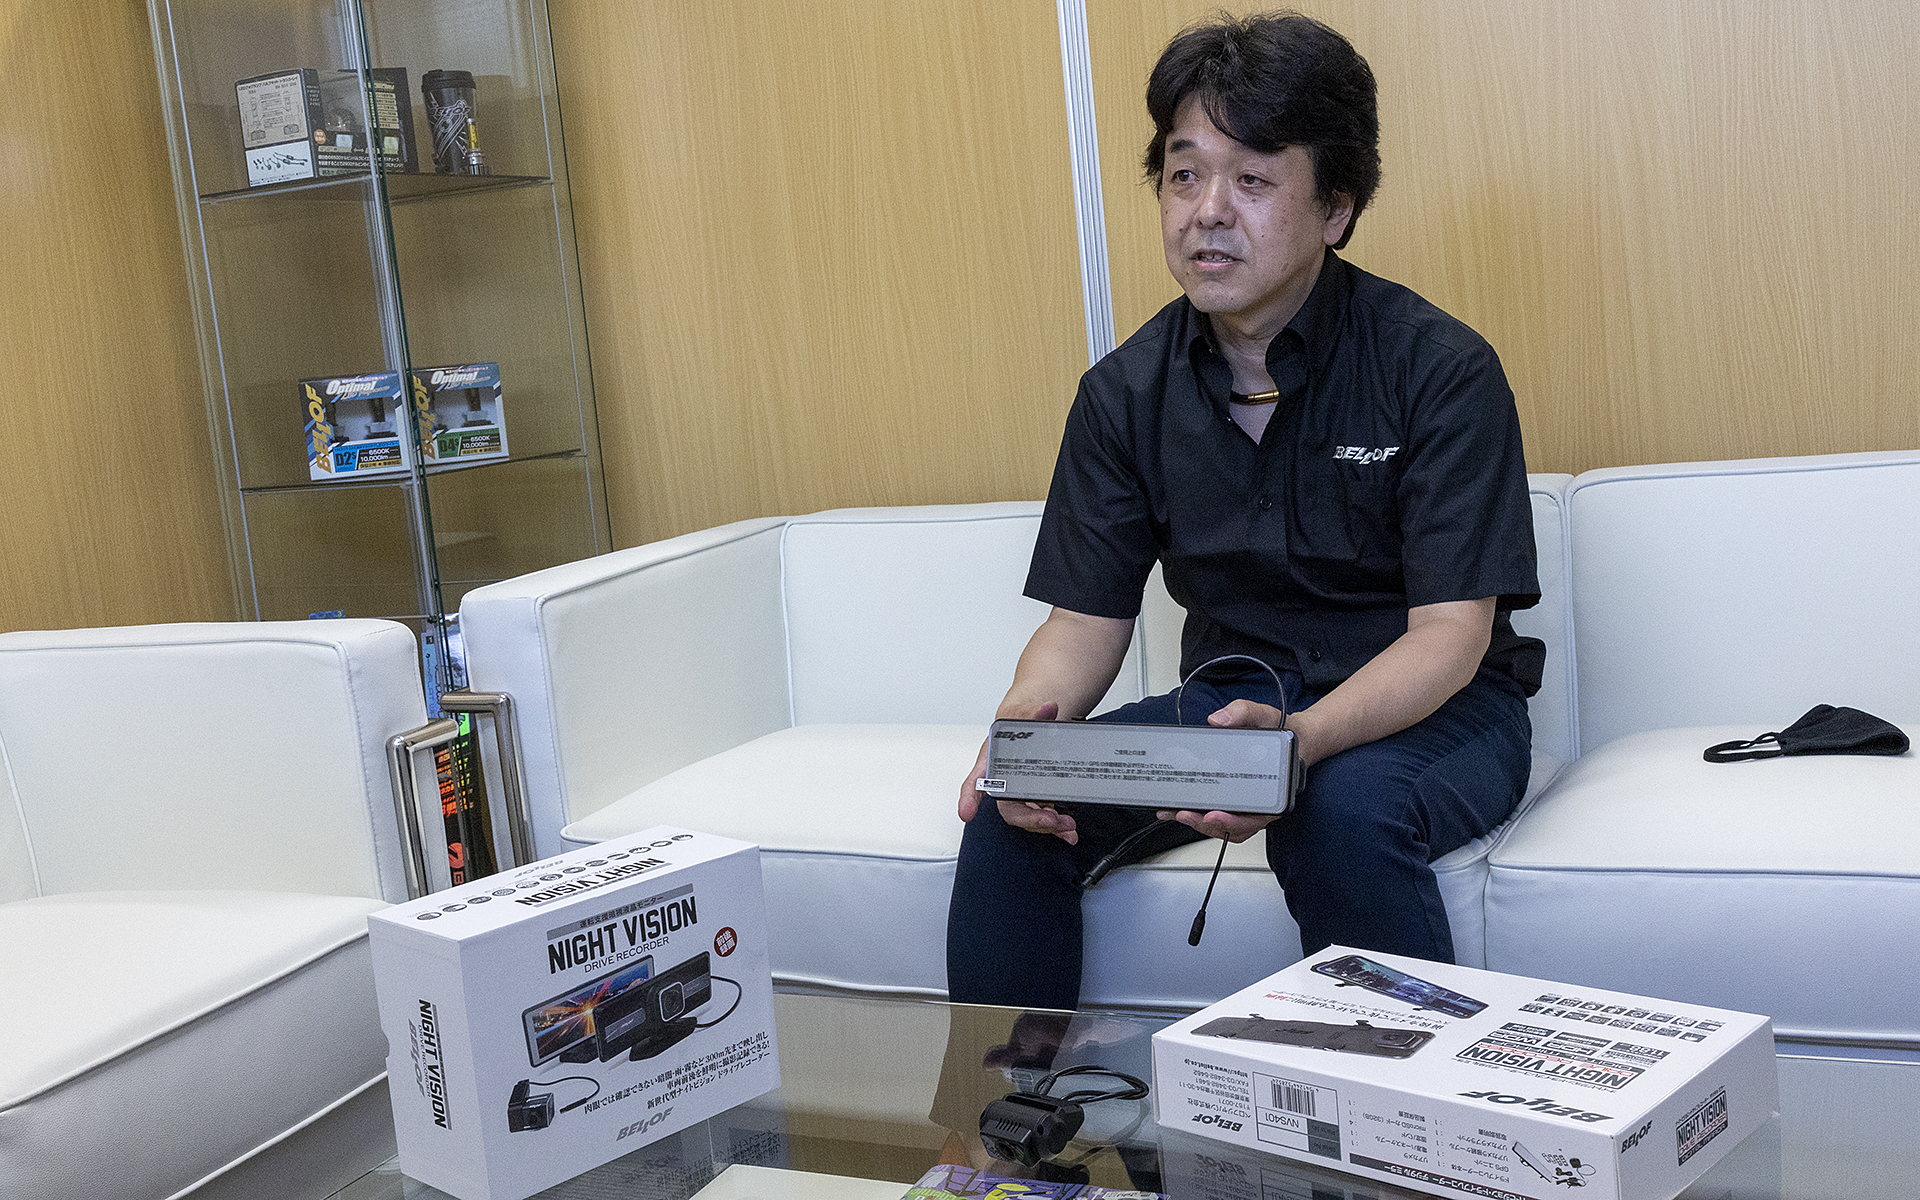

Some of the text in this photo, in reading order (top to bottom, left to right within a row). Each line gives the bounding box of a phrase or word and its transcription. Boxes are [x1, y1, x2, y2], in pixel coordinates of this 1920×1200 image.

[326, 380, 377, 395] Optimal
[431, 370, 478, 385] Optimal
[305, 383, 332, 473] BELLOF
[1333, 446, 1400, 464] BELLOF
[994, 731, 1034, 741] BELLOF
[596, 858, 665, 882] NIGHT
[515, 879, 599, 906] VISION
[548, 896, 698, 974] NIGHT VISION
[584, 936, 670, 973] DRIVE RECORDER
[419, 999, 438, 1060] NIGHT
[408, 1019, 425, 1098] BELLOF
[718, 1052, 770, 1079] ドライブレコーダー
[1463, 1047, 1628, 1087] NIGHT VISION
[427, 1065, 447, 1129] VISION
[1456, 1090, 1615, 1123] BELLOF
[616, 1107, 674, 1141] BELLOF
[1192, 1113, 1243, 1132] BELLOF
[1265, 1112, 1299, 1128] NVS401
[1677, 1114, 1700, 1147] NIGHT
[1700, 1094, 1726, 1128] VISION
[1457, 1135, 1508, 1151] リアカメラブラケット
[1621, 1120, 1653, 1153] BELLOF
[1384, 1165, 1403, 1175] ミラー
[1403, 1152, 1429, 1163] リアカメラ
[1473, 1159, 1493, 1168] ユニット
[1495, 1164, 1509, 1172] GPS
[1403, 1168, 1429, 1181] デジタル
